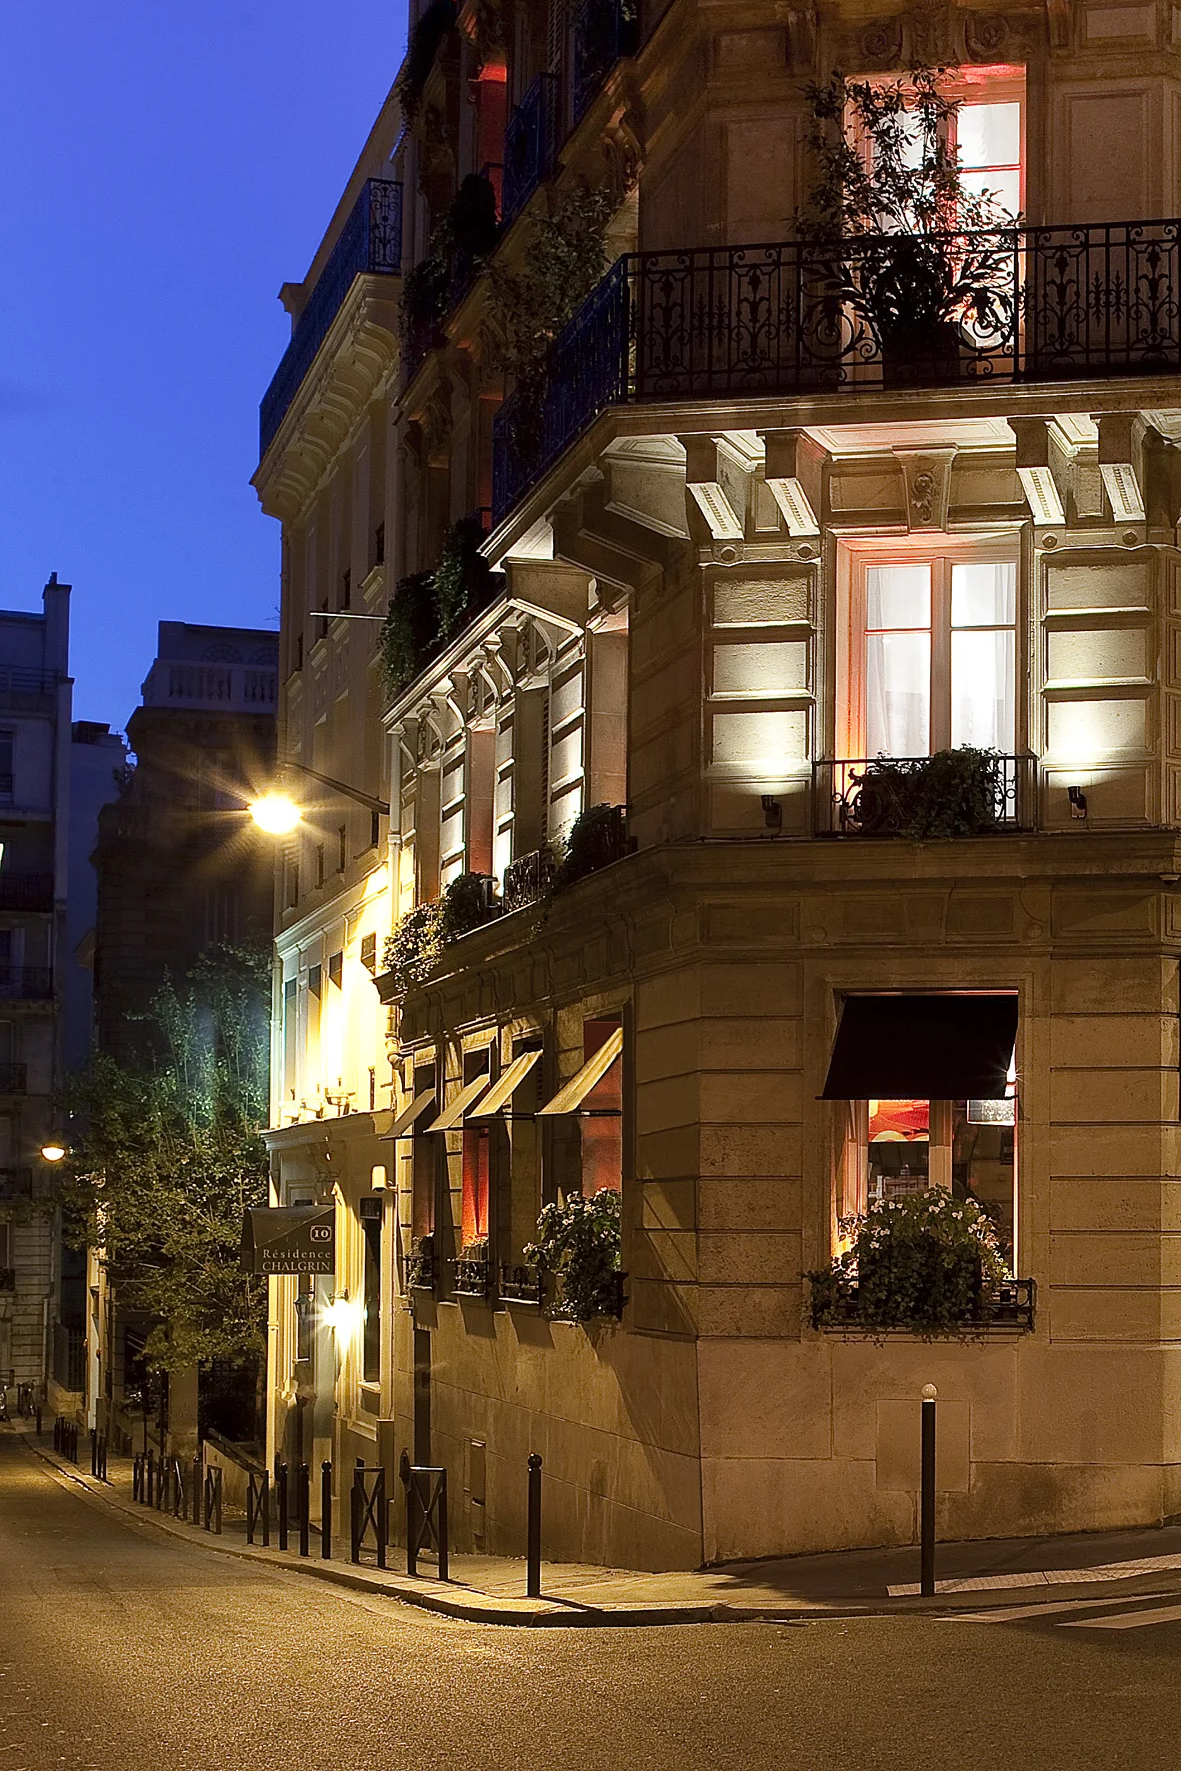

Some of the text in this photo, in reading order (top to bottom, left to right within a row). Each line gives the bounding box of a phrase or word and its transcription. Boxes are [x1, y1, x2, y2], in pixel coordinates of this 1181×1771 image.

[314, 1229, 329, 1238] 10
[263, 1249, 331, 1259] Résidence
[262, 1261, 330, 1271] CHALGRIN
